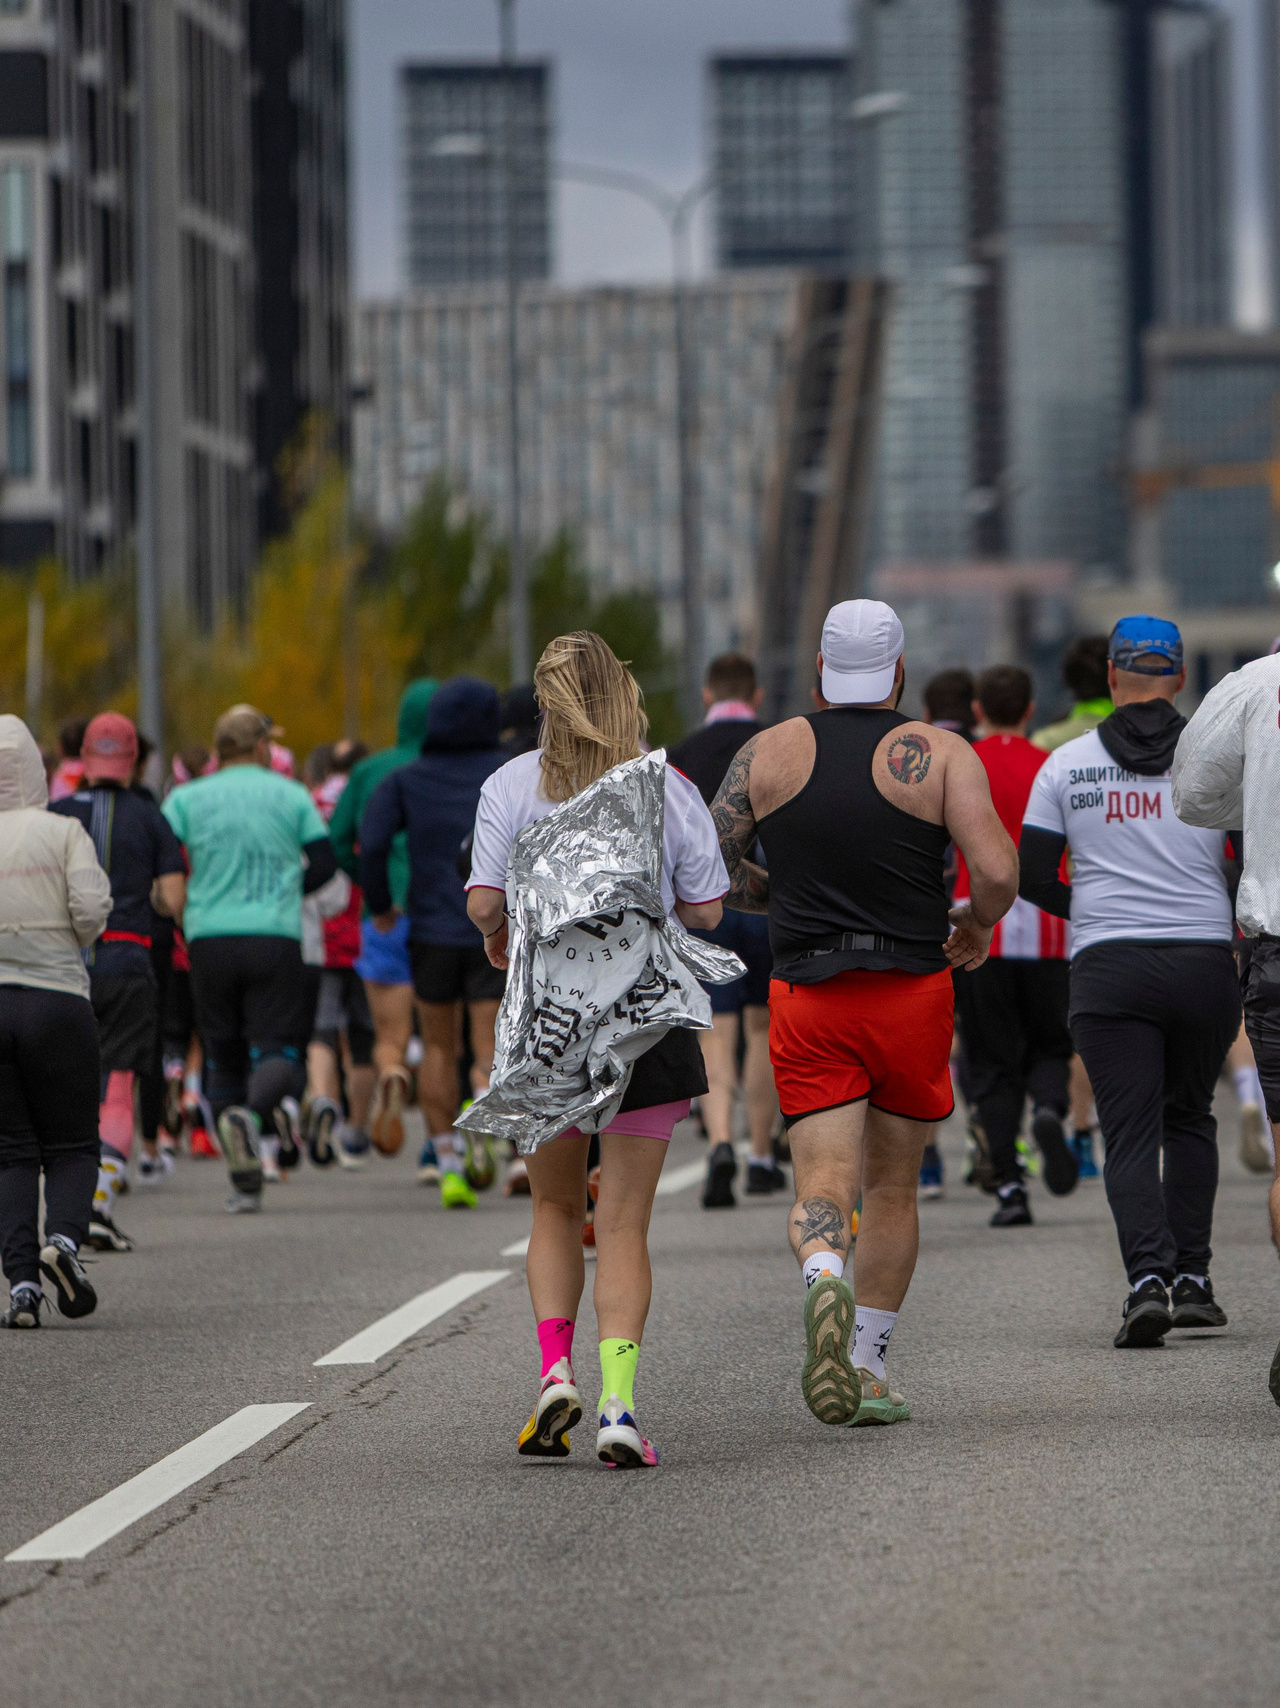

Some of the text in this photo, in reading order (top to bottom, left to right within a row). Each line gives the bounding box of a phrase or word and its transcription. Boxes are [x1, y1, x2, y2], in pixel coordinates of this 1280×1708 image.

[1069, 766, 1137, 785] ЗАЩИТИМ
[1070, 787, 1162, 824] СВОЙ ДОМ
